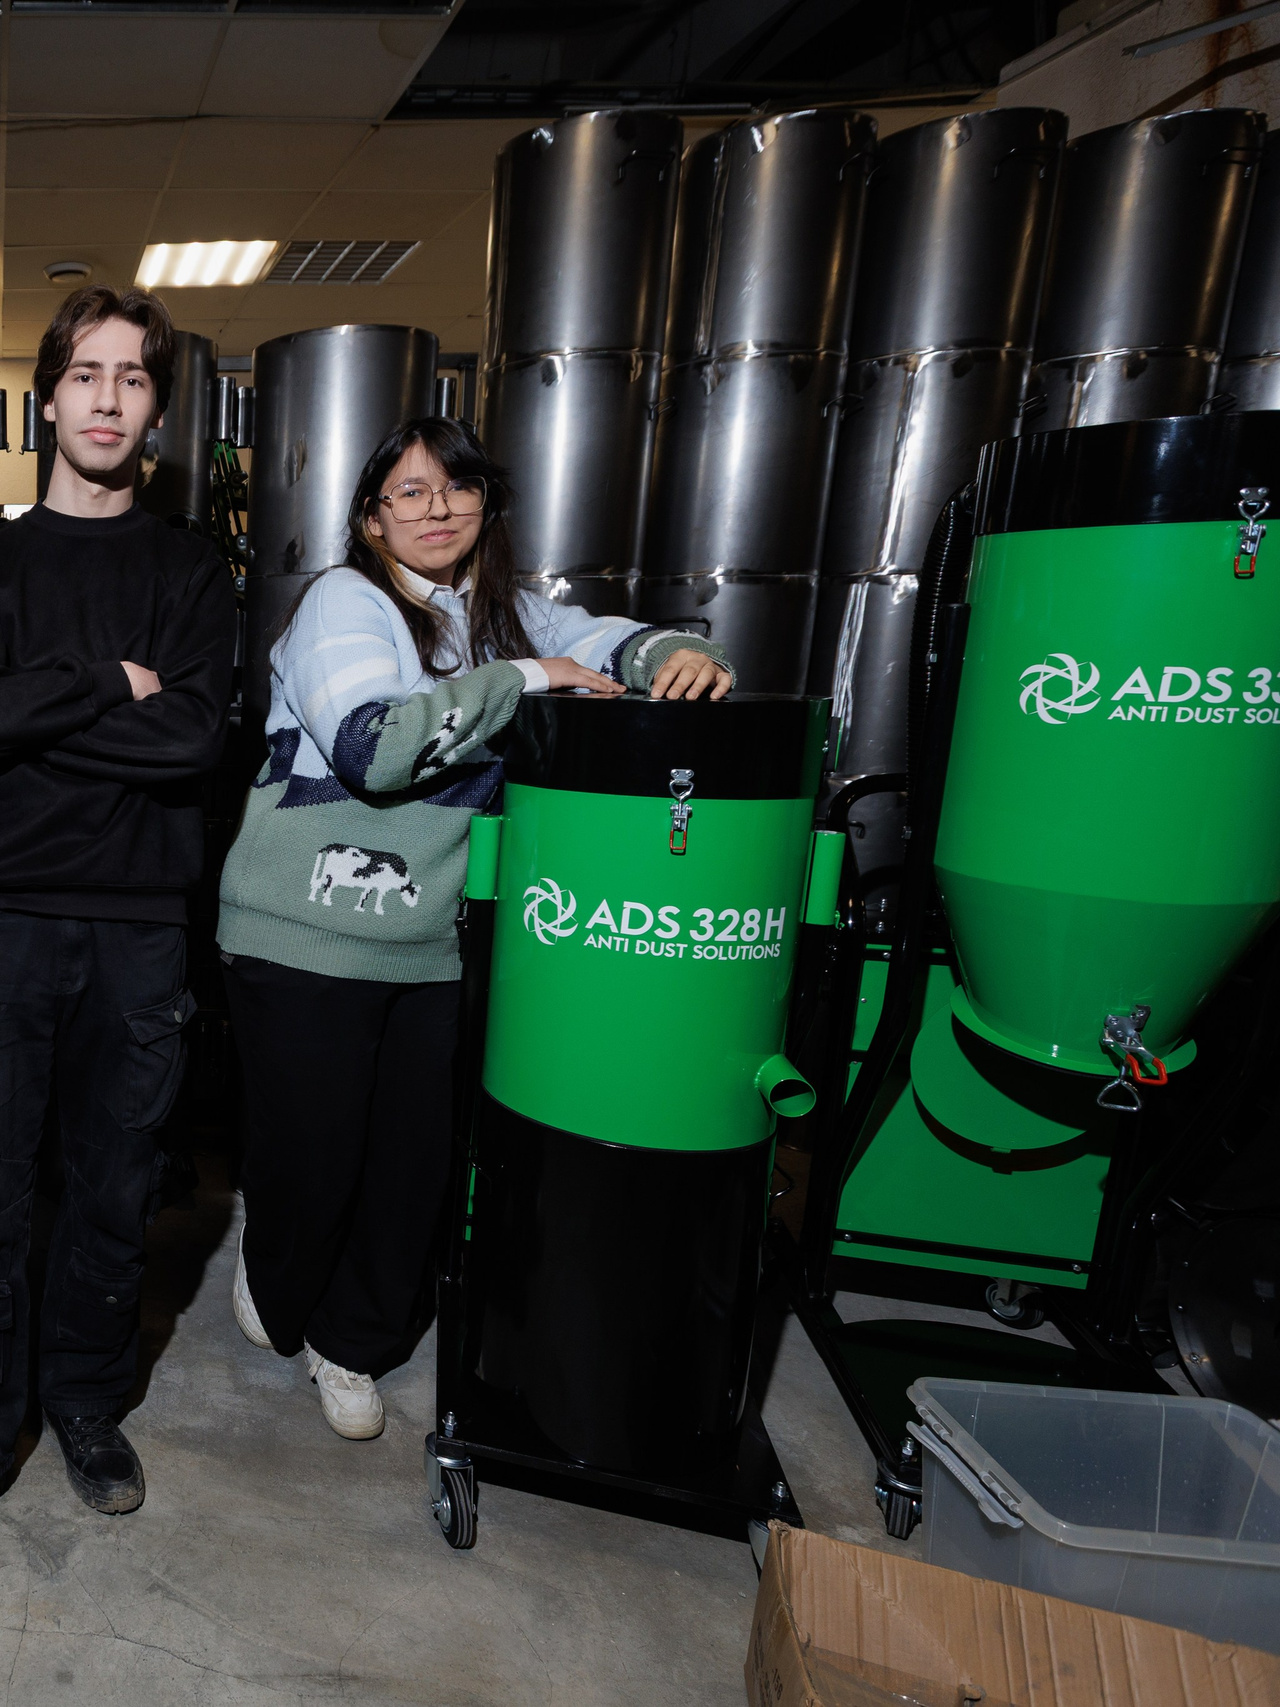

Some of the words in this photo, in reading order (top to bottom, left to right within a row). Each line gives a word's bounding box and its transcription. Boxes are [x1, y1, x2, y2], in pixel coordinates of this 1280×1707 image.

[1111, 666, 1233, 703] ADS
[1243, 668, 1280, 704] 3
[1108, 705, 1168, 722] ANTI
[1175, 707, 1239, 723] DUST
[585, 899, 680, 939] ADS
[689, 906, 786, 942] 328H
[584, 933, 629, 952] ANTI
[635, 940, 688, 958] DUST
[692, 943, 780, 960] SOLUTIONS
